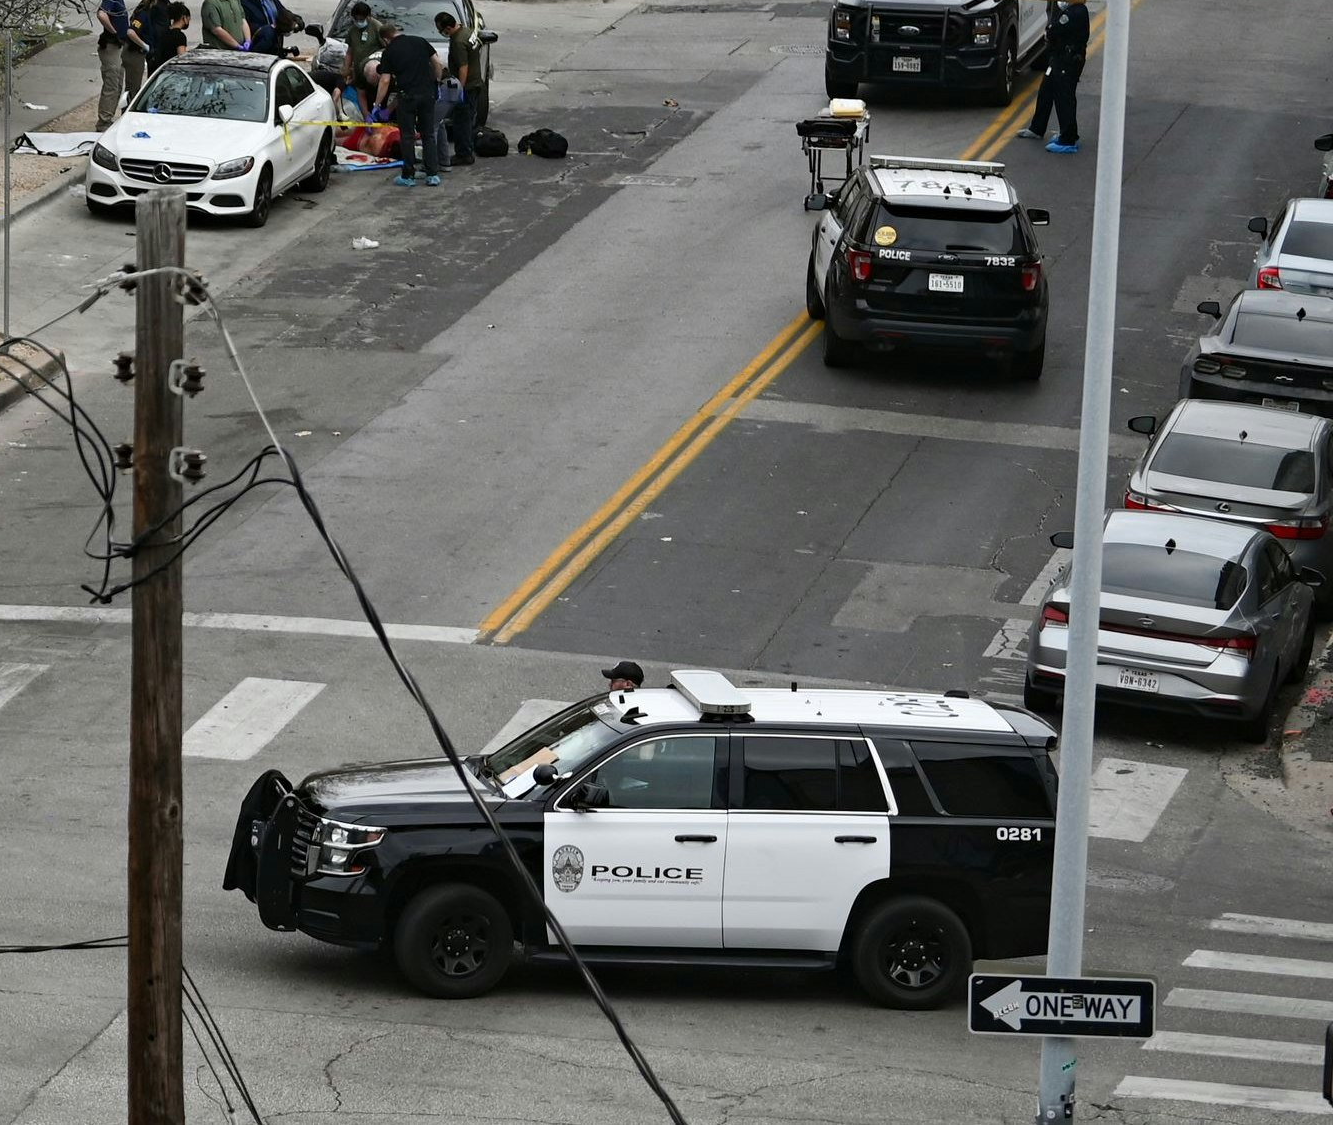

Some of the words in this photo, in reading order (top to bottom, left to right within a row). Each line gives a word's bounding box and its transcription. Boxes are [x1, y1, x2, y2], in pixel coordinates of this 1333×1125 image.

[879, 249, 911, 261] POLICE
[984, 257, 1016, 266] 7832
[996, 827, 1042, 841] 0281
[591, 865, 704, 880] POLICE
[1026, 995, 1073, 1017] ONE
[1084, 997, 1134, 1020] WAY
